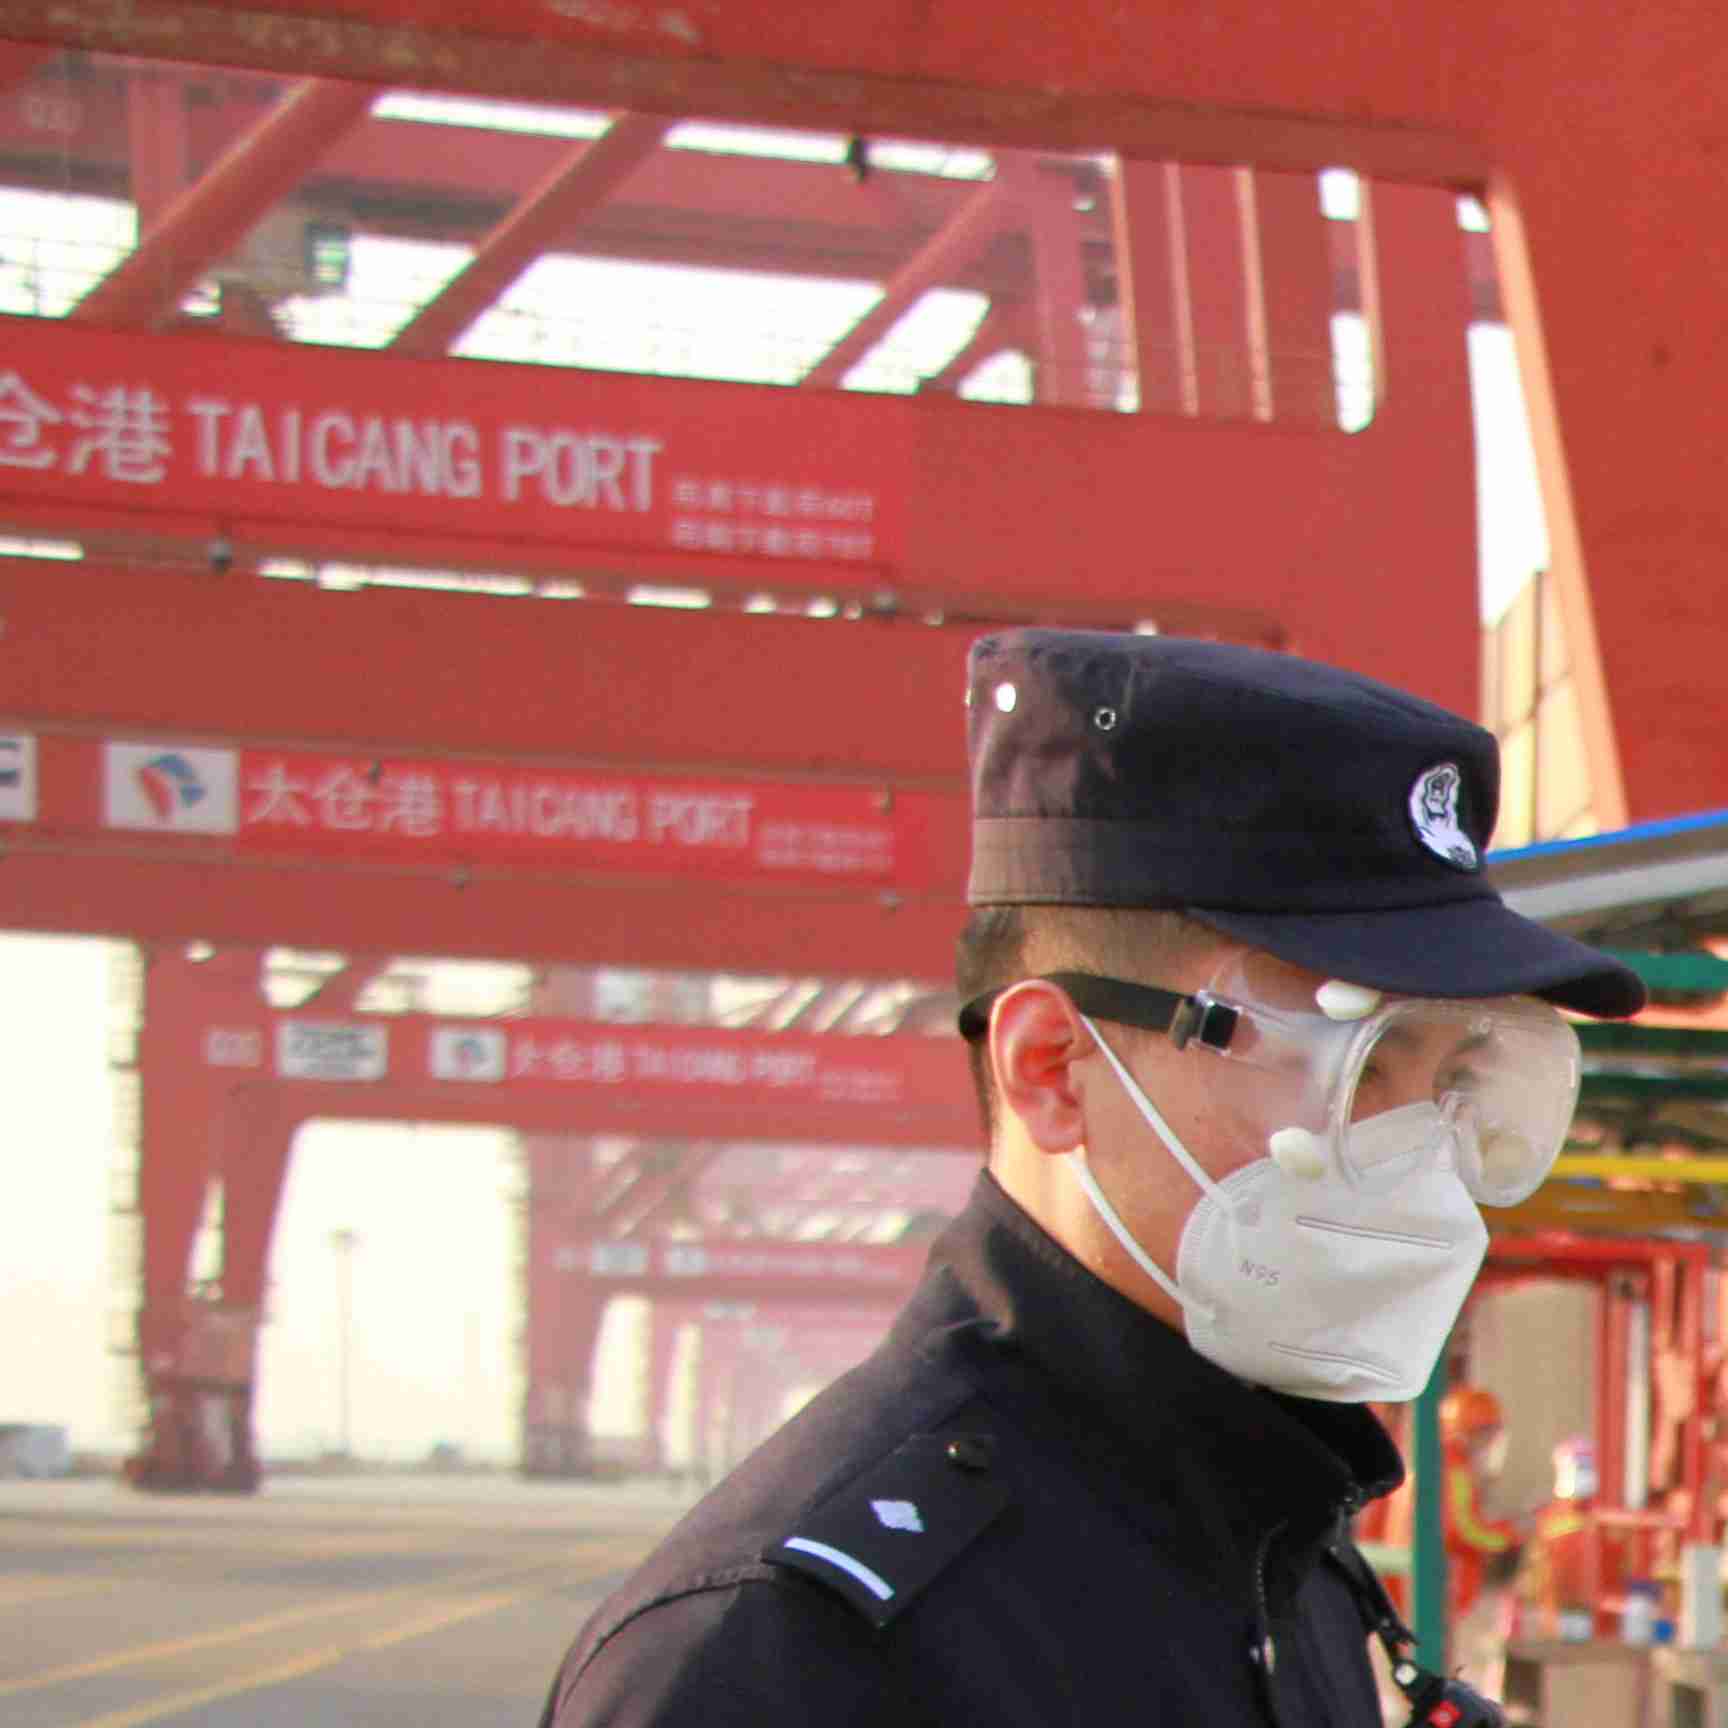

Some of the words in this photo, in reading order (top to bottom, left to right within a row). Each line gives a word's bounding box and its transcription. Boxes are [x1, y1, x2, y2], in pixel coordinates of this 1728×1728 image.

[188, 398, 481, 500] TAICANG
[503, 428, 663, 513] PORT
[247, 763, 437, 836] 太仓港
[454, 780, 638, 841] TAICANG
[648, 792, 754, 846] PORT
[1239, 1259, 1281, 1287] N95
